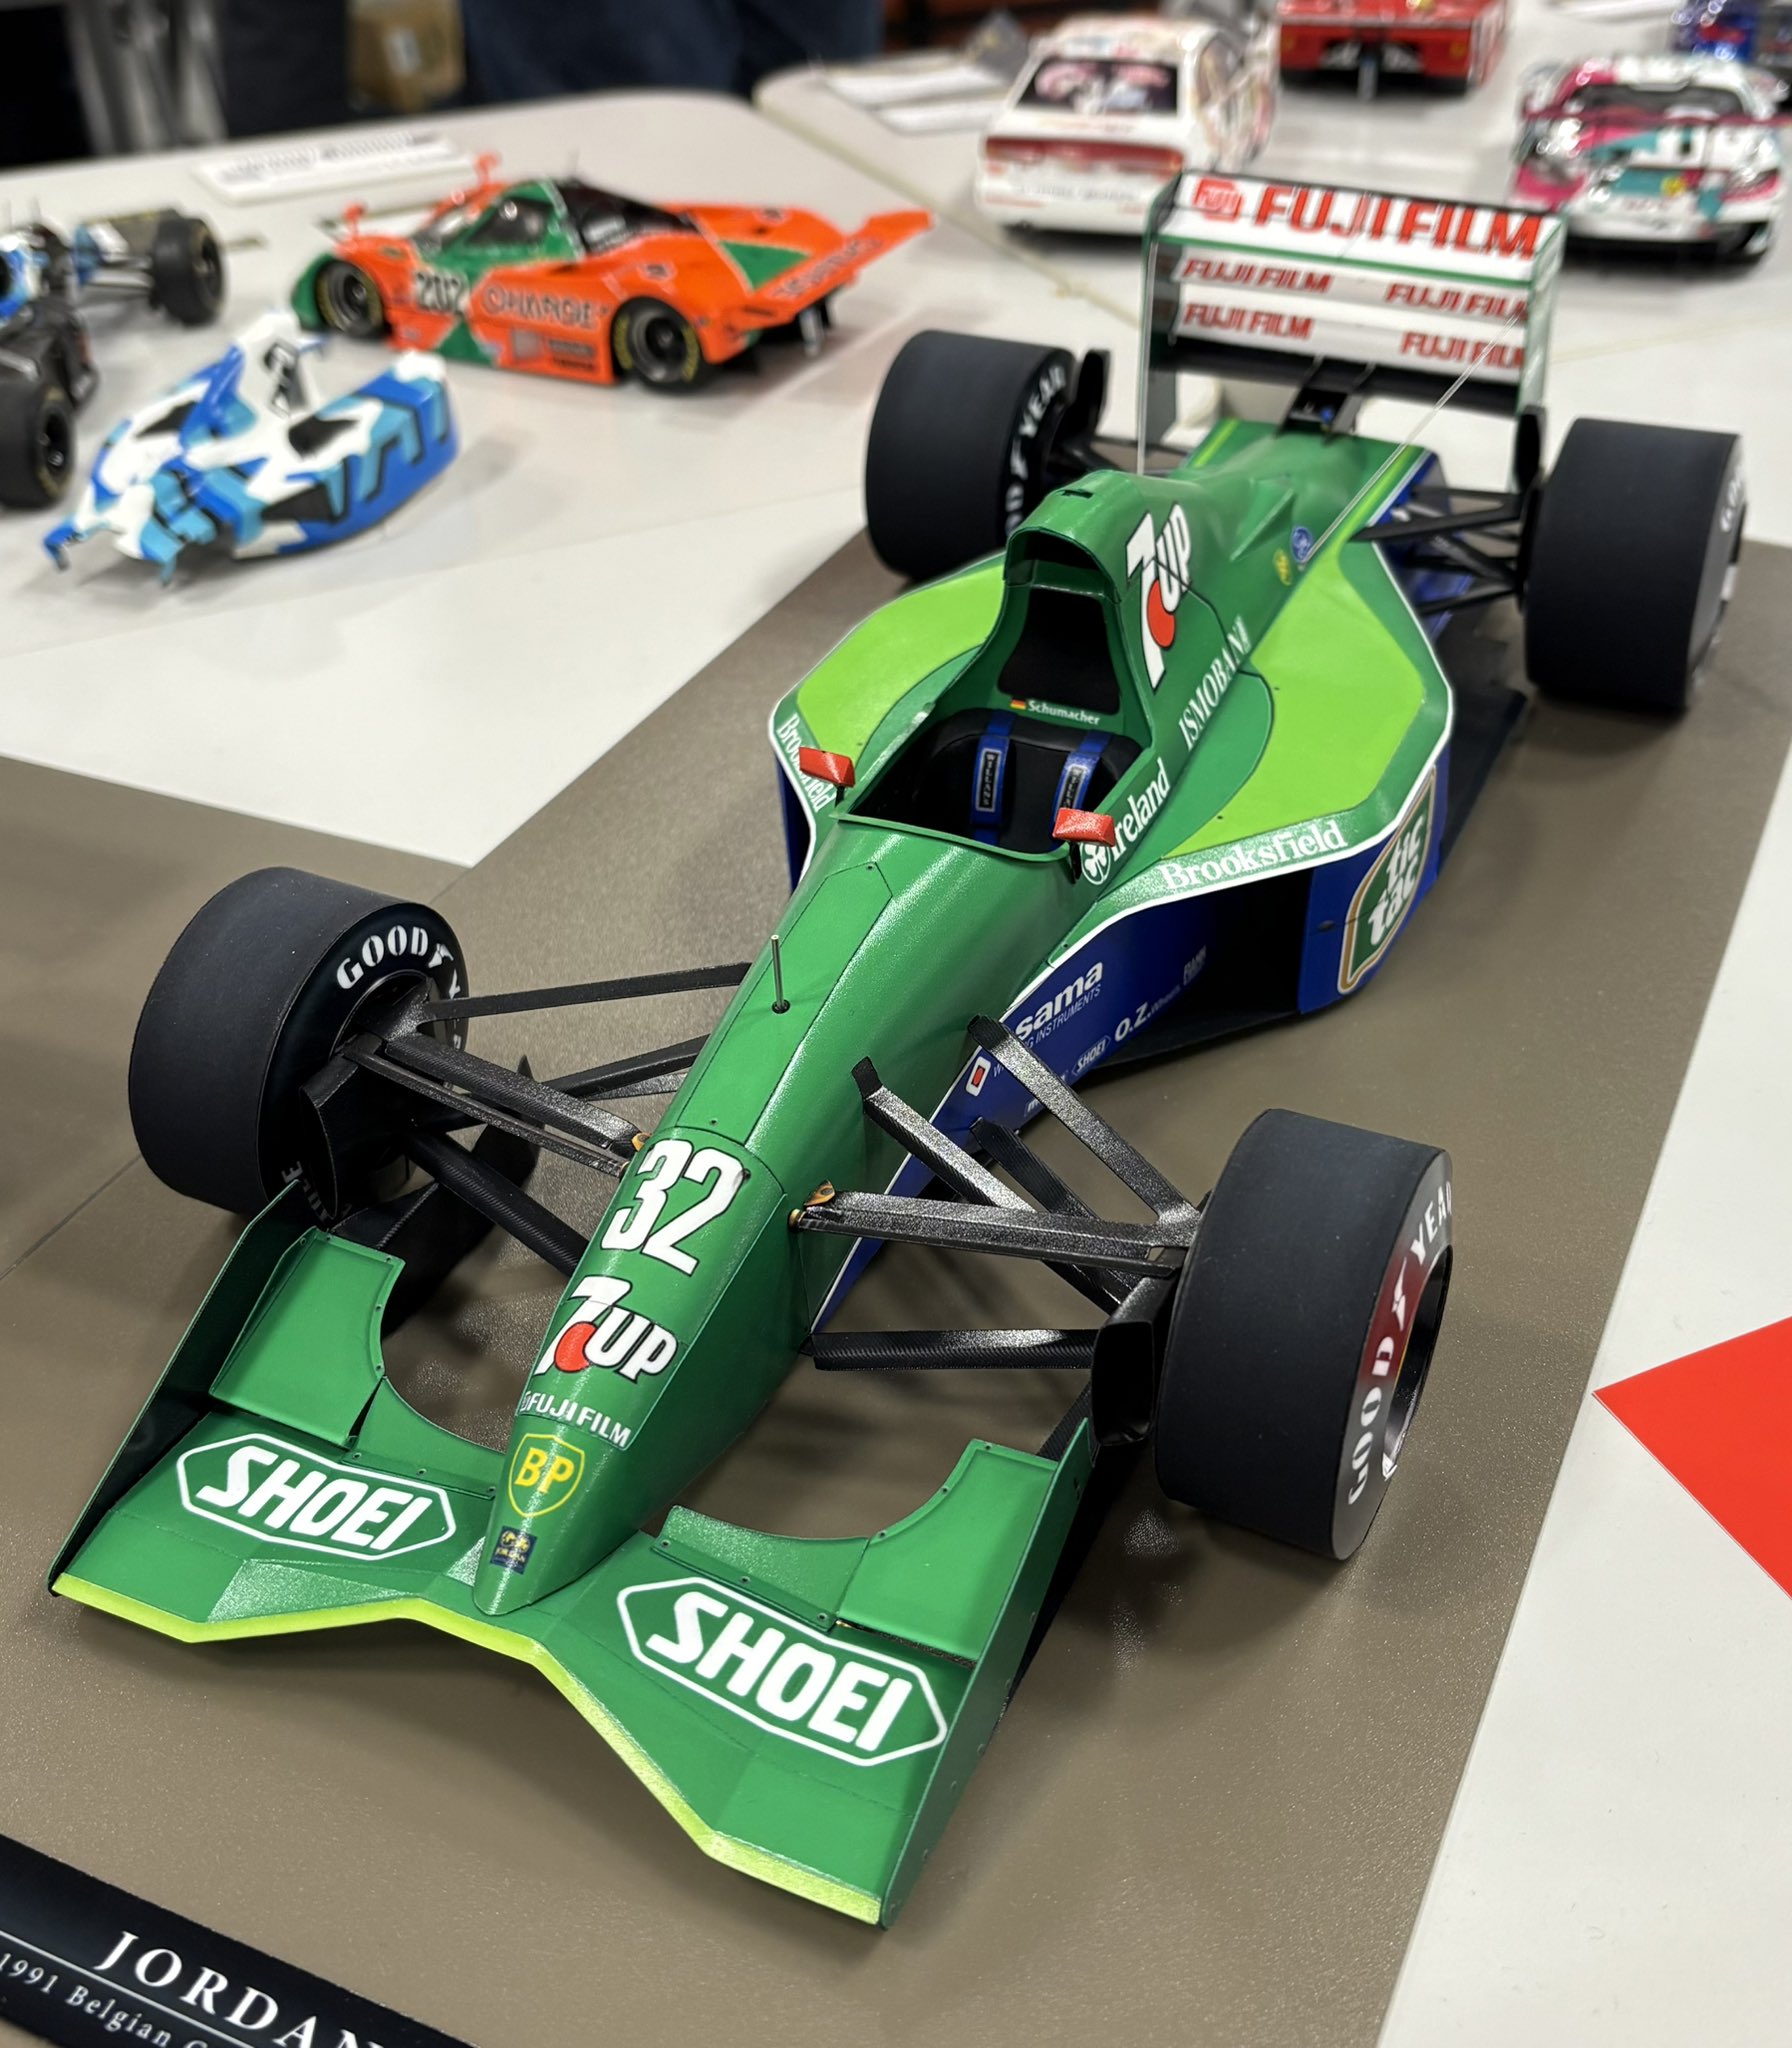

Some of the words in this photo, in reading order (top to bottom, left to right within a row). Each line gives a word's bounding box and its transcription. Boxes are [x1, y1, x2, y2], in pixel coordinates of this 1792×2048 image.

[1125, 501, 1193, 694] 7UP
[1027, 699, 1100, 725] Schumacher
[1112, 756, 1171, 861] Ireland
[1159, 818, 1349, 891] Brooksfield
[1386, 814, 1426, 891] tic
[1368, 853, 1419, 946] tac
[336, 924, 429, 990] GOOD
[1035, 984, 1102, 1046] INSTRUMENTS
[600, 1138, 745, 1276] 32
[536, 1275, 678, 1382] 7UP
[195, 1445, 433, 1551] SHOEI
[513, 1446, 575, 1494] BP
[645, 1590, 913, 1752] SHOEI
[64, 1984, 173, 2048] Belgian
